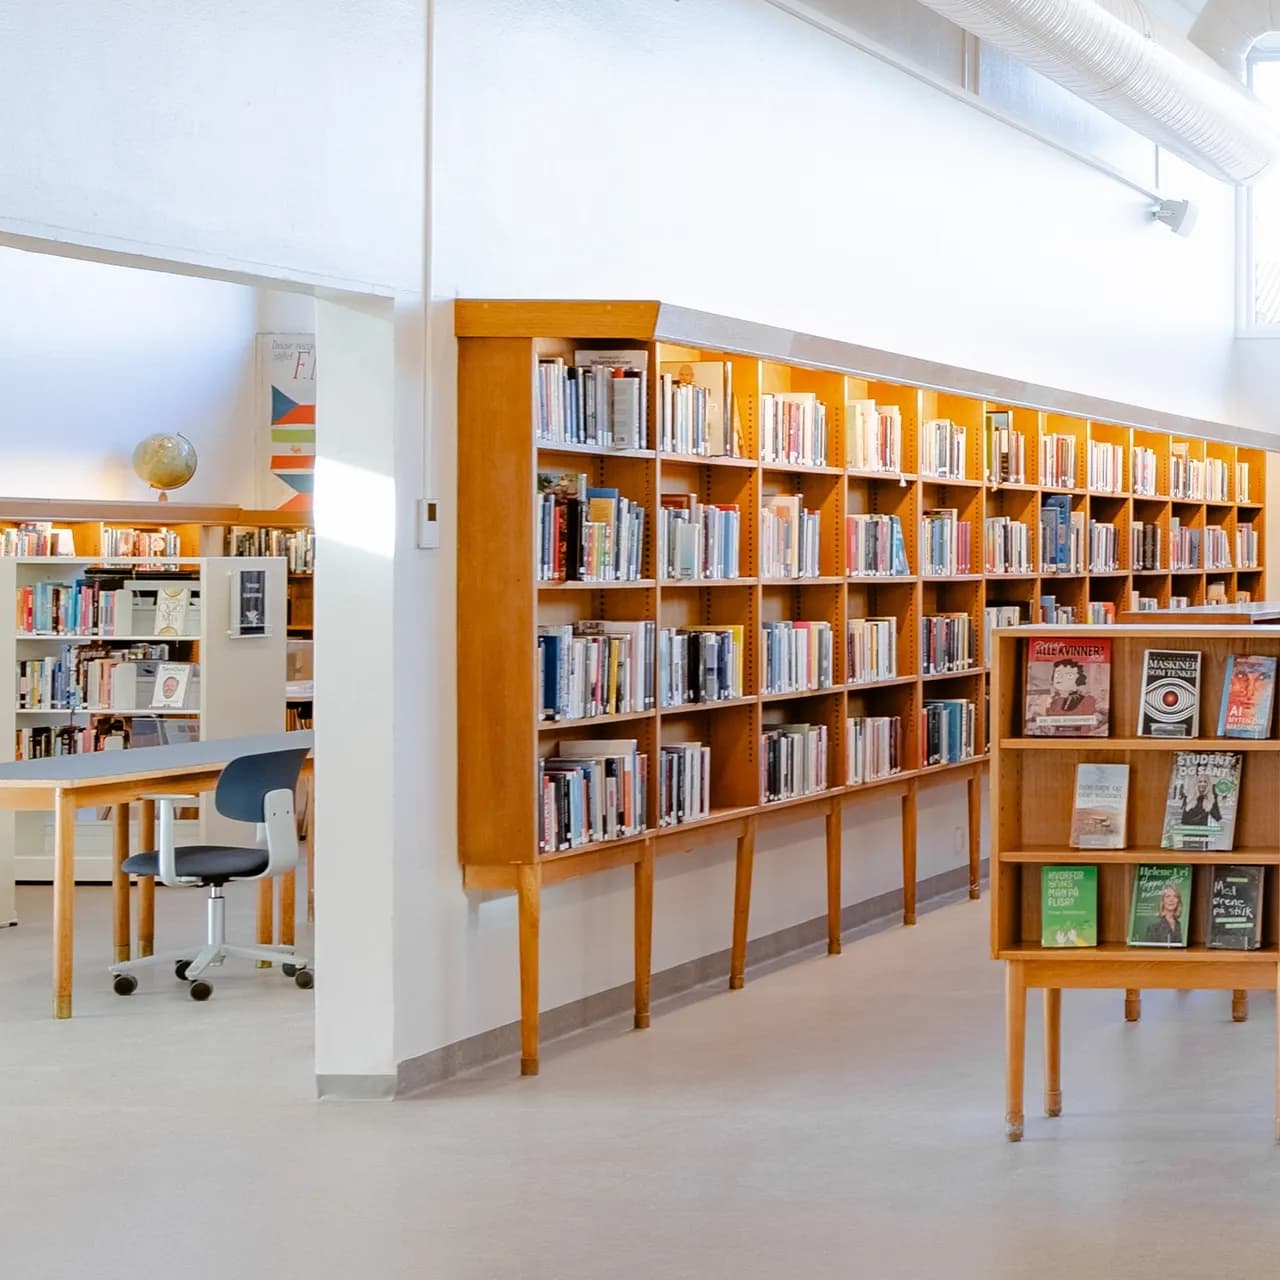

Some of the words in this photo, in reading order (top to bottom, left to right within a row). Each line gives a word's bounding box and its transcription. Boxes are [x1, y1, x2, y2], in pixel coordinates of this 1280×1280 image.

[1148, 669, 1166, 677] SOM
[1229, 706, 1242, 716] AI
[1179, 766, 1195, 776] OG
[1068, 887, 1079, 897] PÅ
[1213, 896, 1246, 907] ørene
[1213, 907, 1226, 916] på
[1228, 906, 1254, 918] stilk
